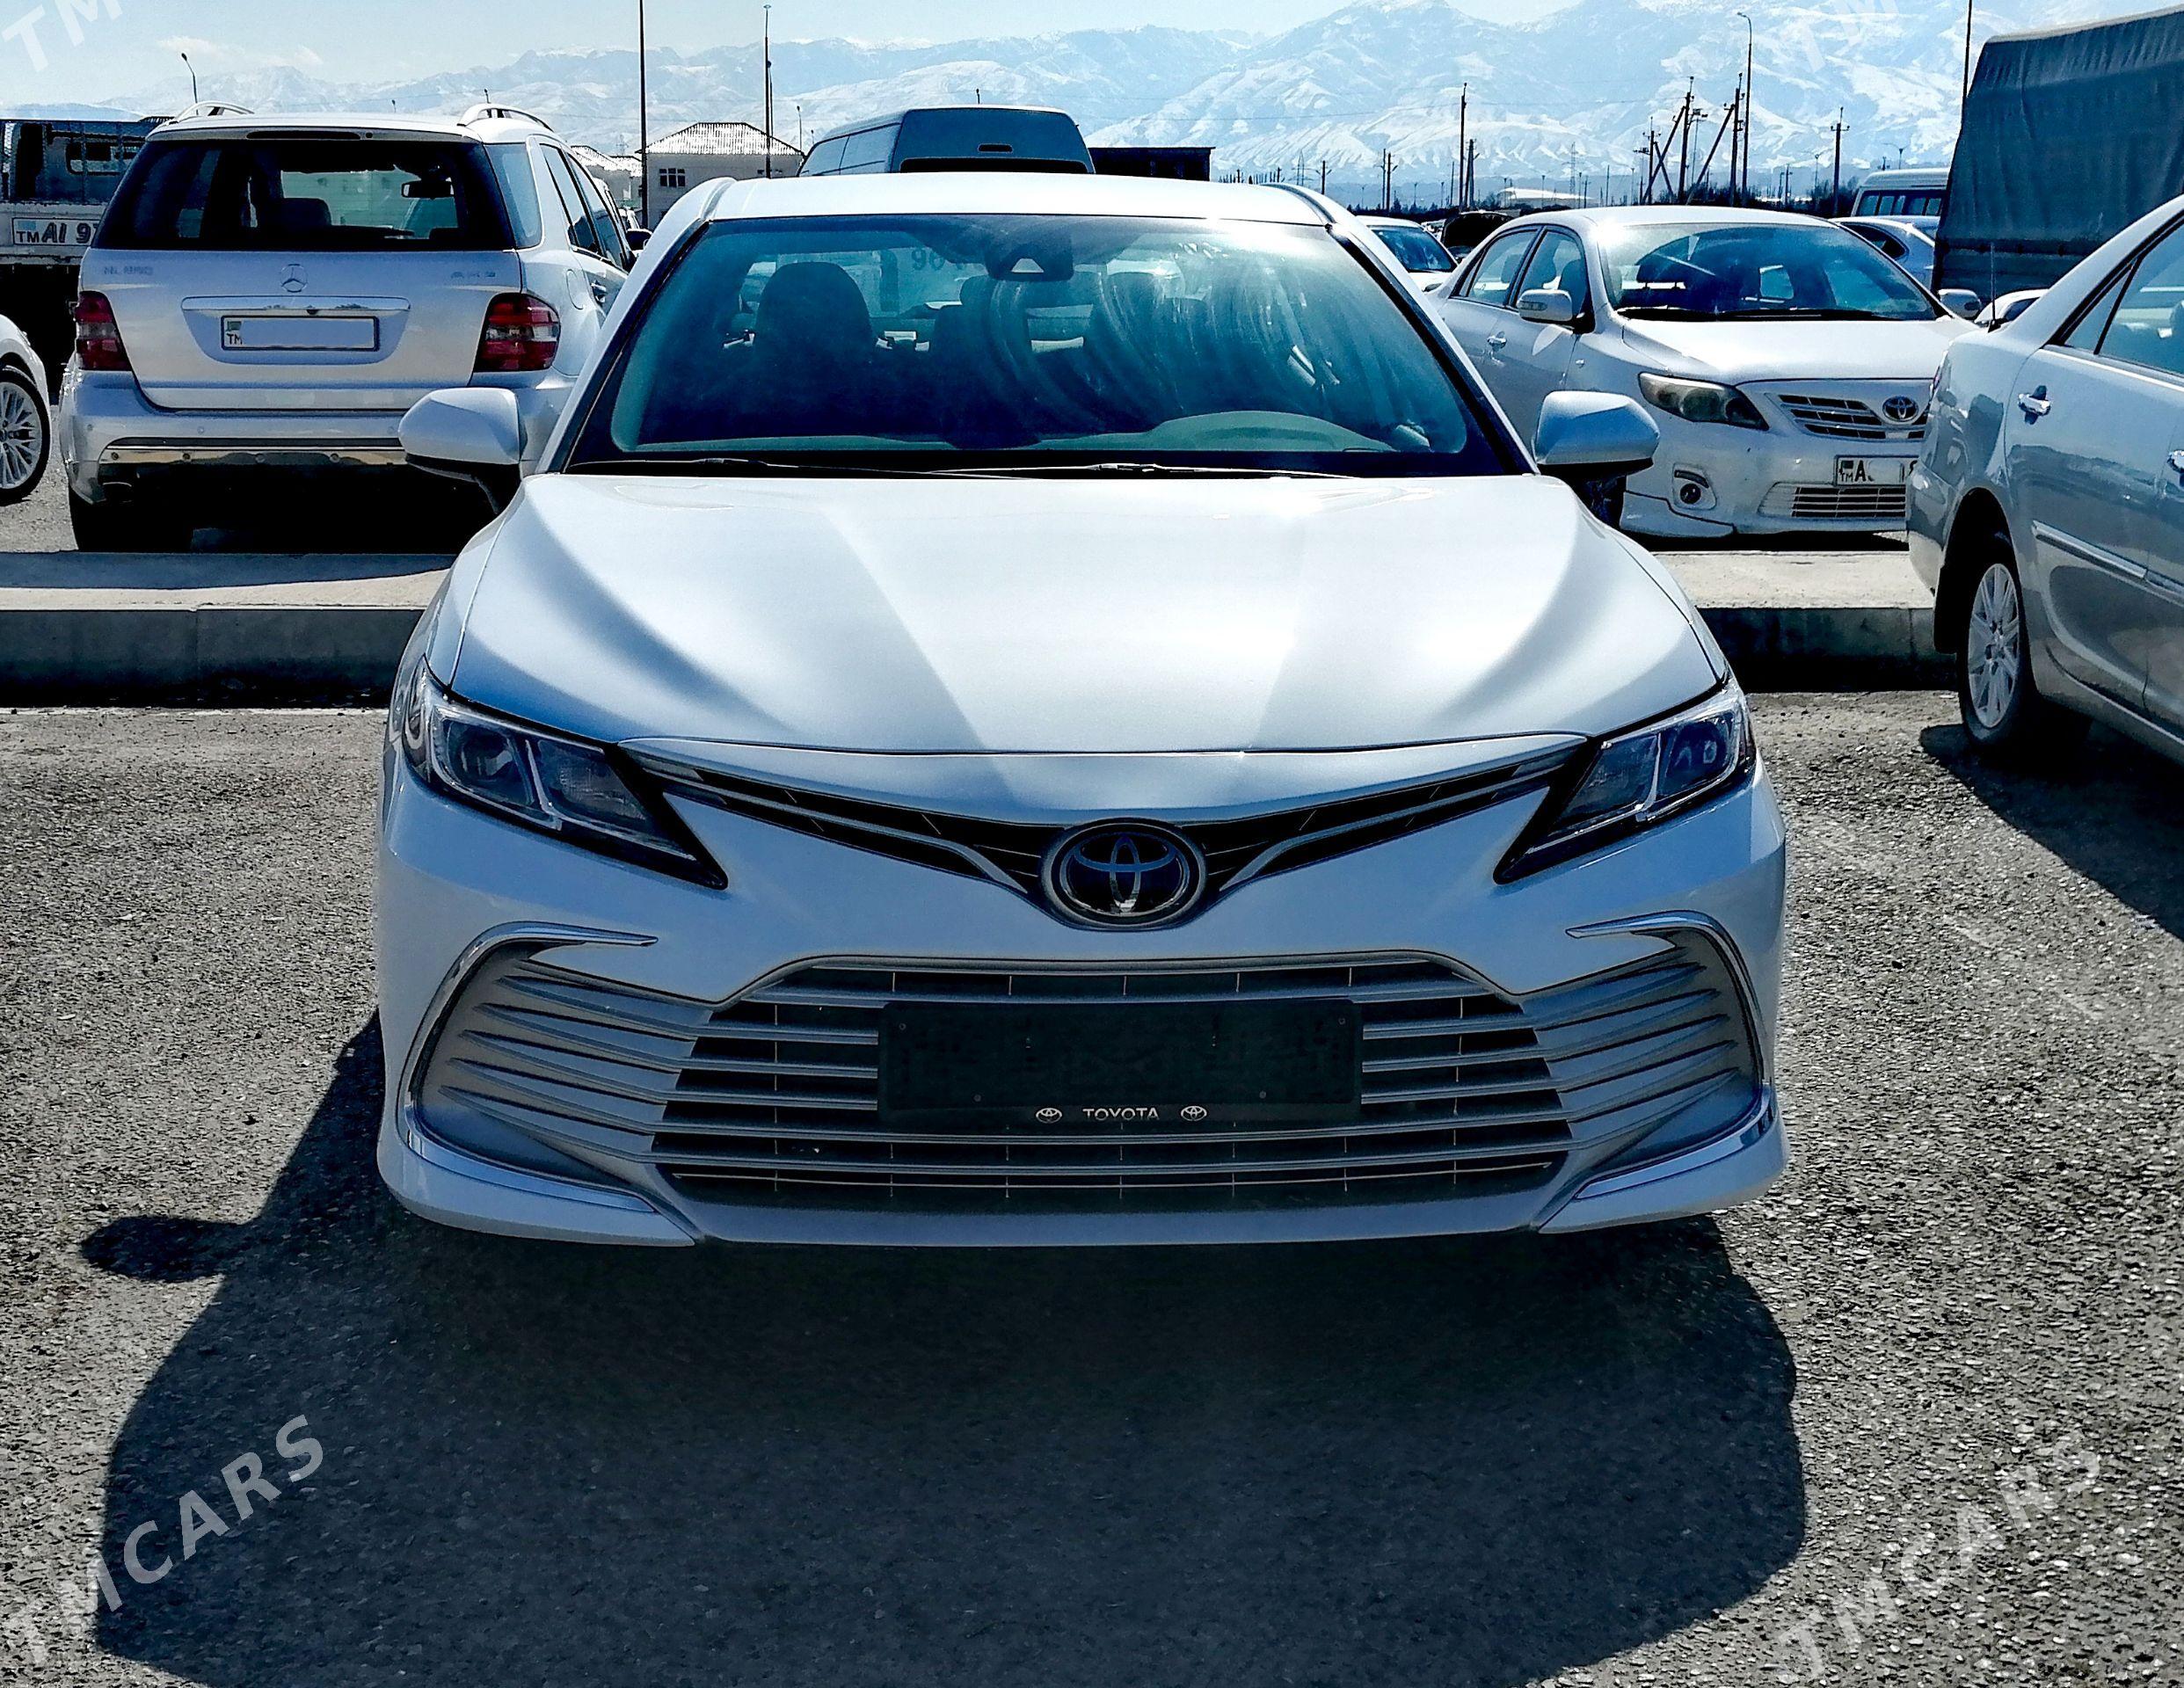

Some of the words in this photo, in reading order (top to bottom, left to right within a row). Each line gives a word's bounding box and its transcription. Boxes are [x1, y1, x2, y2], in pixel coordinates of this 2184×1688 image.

[17, 231, 40, 243] TM
[41, 222, 67, 244] AI
[76, 222, 100, 244] 9
[226, 332, 243, 345] TM
[1082, 1108, 1159, 1121] TOYOTA
